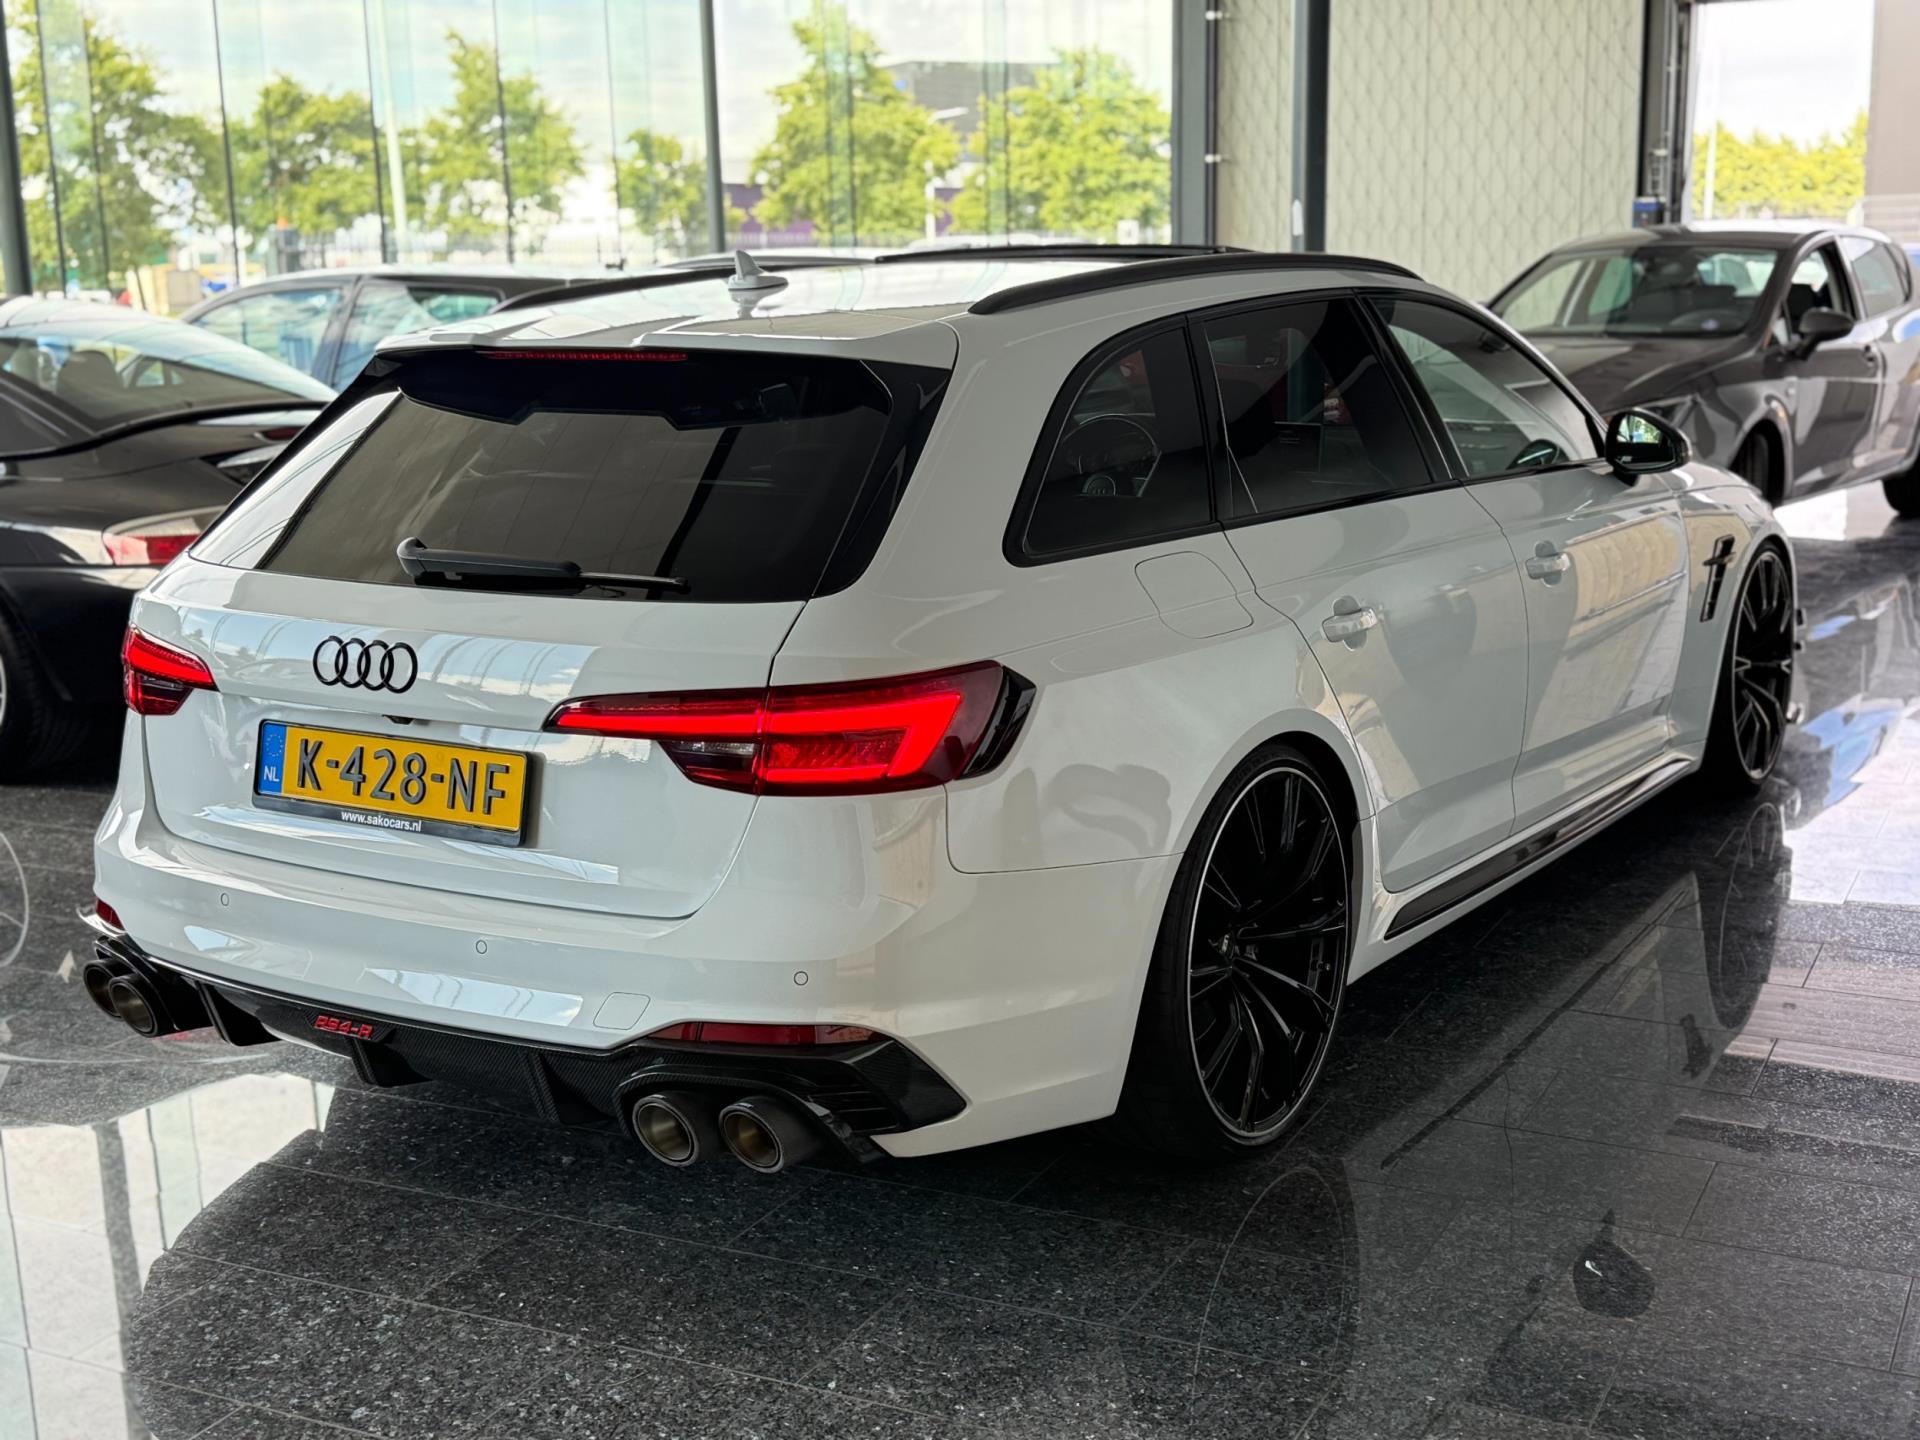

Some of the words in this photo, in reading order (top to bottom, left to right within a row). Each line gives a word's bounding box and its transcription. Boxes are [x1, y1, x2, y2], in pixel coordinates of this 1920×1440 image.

[263, 765, 280, 782] NL
[297, 738, 510, 815] K-428-NF
[341, 811, 422, 832] www.sakocars.nl
